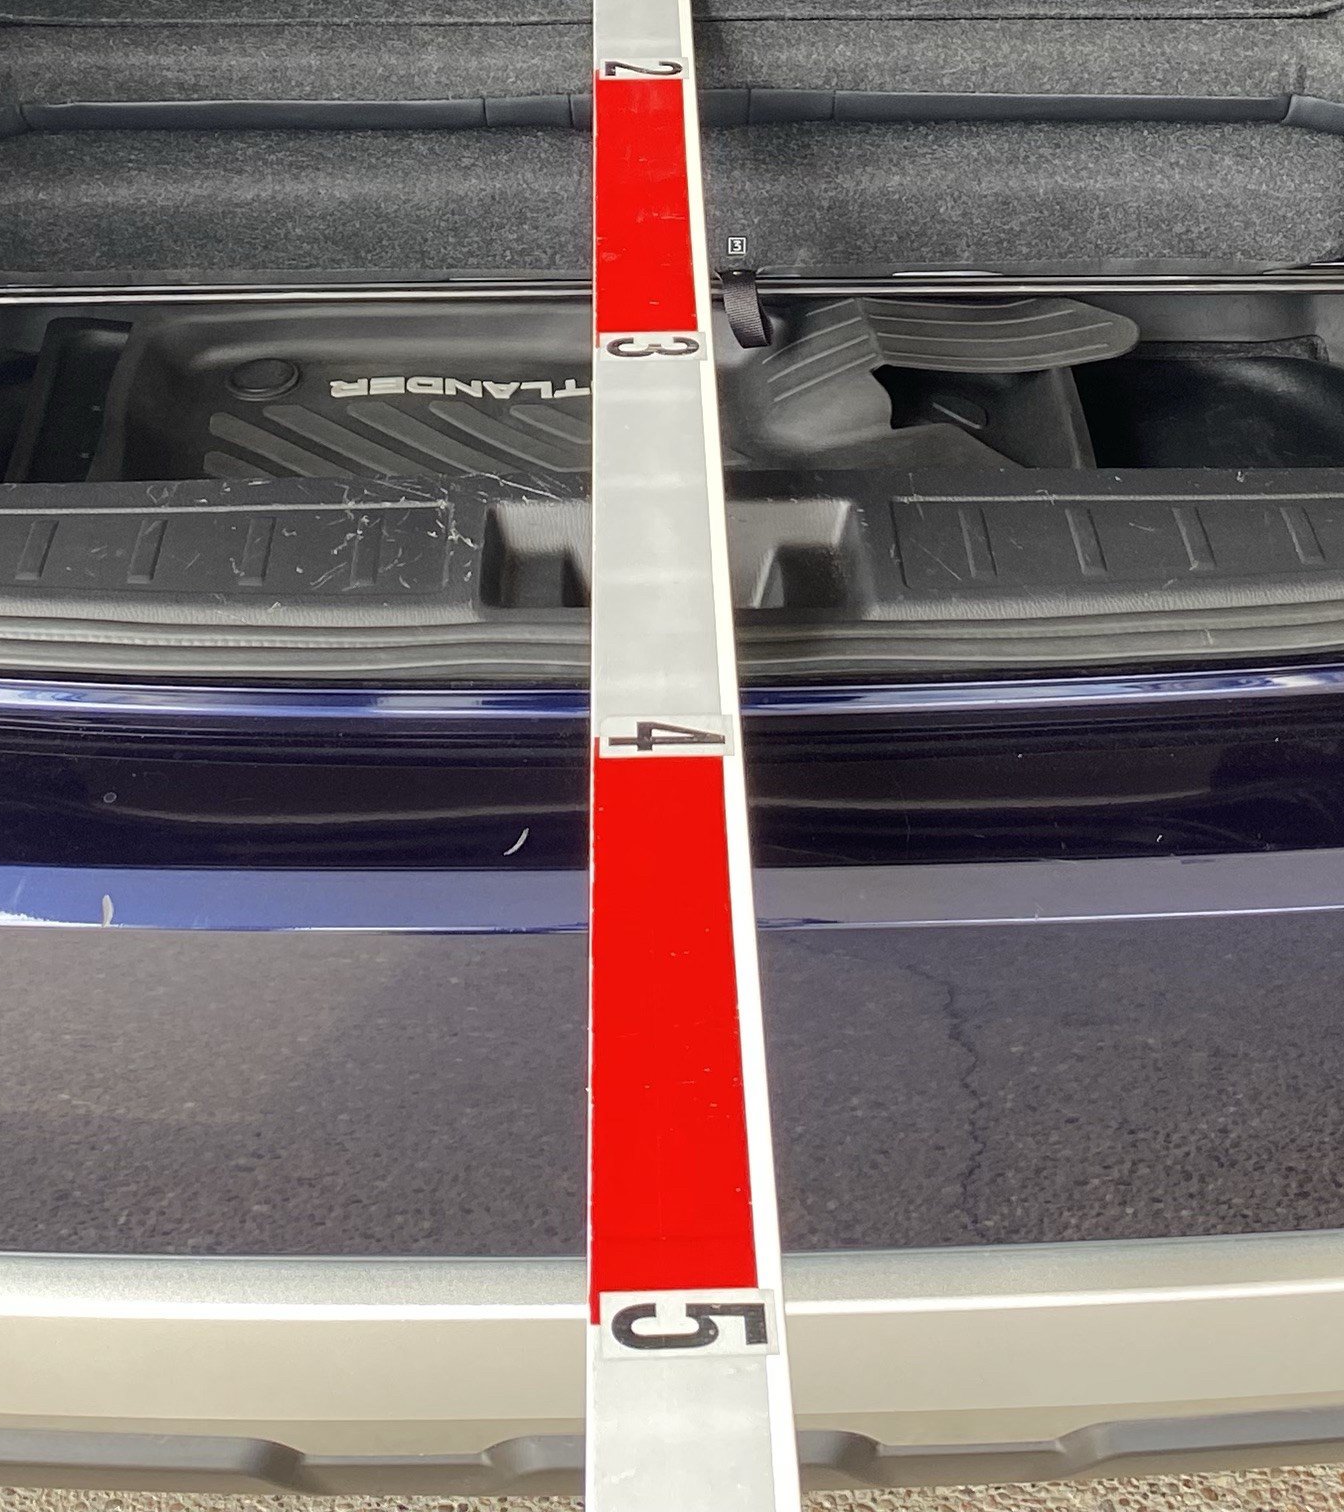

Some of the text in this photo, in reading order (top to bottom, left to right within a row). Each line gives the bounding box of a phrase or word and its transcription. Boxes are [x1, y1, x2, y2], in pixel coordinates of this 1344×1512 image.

[604, 61, 683, 76] 2
[606, 336, 700, 358] 3
[329, 376, 593, 399] TLANDER
[608, 721, 726, 751] 4
[611, 1302, 769, 1350] 5
